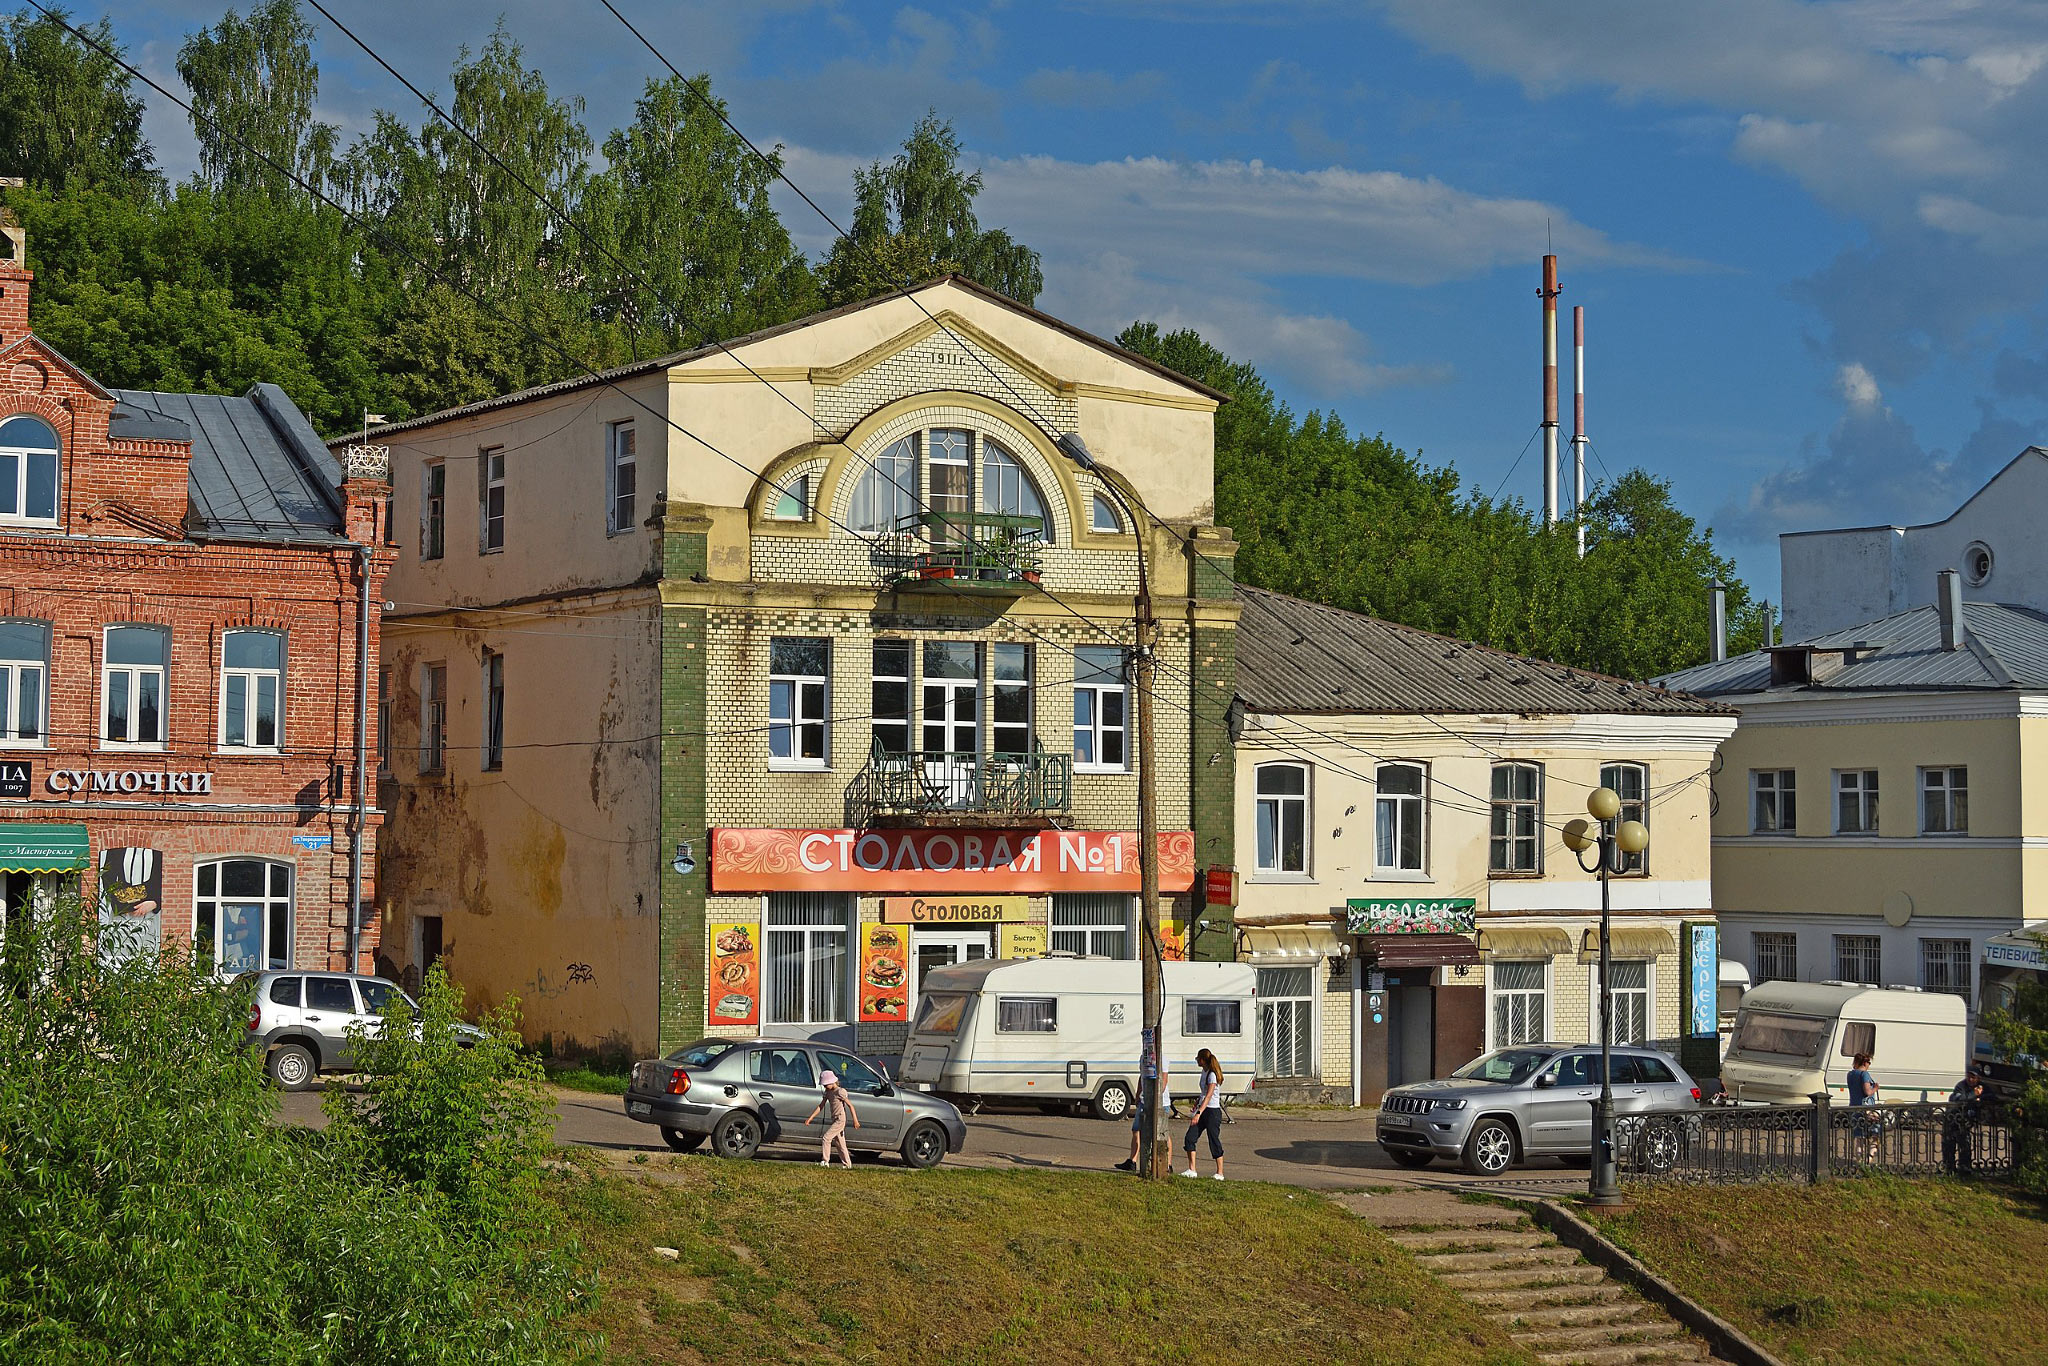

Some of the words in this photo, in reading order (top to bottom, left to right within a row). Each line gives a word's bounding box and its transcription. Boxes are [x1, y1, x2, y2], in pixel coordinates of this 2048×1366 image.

[49, 769, 214, 793] СУМОЧКИ
[309, 841, 317, 849] 21
[9, 846, 74, 857] Мастерская
[800, 834, 1041, 873] СТОЛОВАЯ
[1058, 835, 1122, 873] №1
[911, 898, 1003, 921] Столовая
[1013, 934, 1036, 943] Быстро
[1013, 946, 1036, 954] Вкусно
